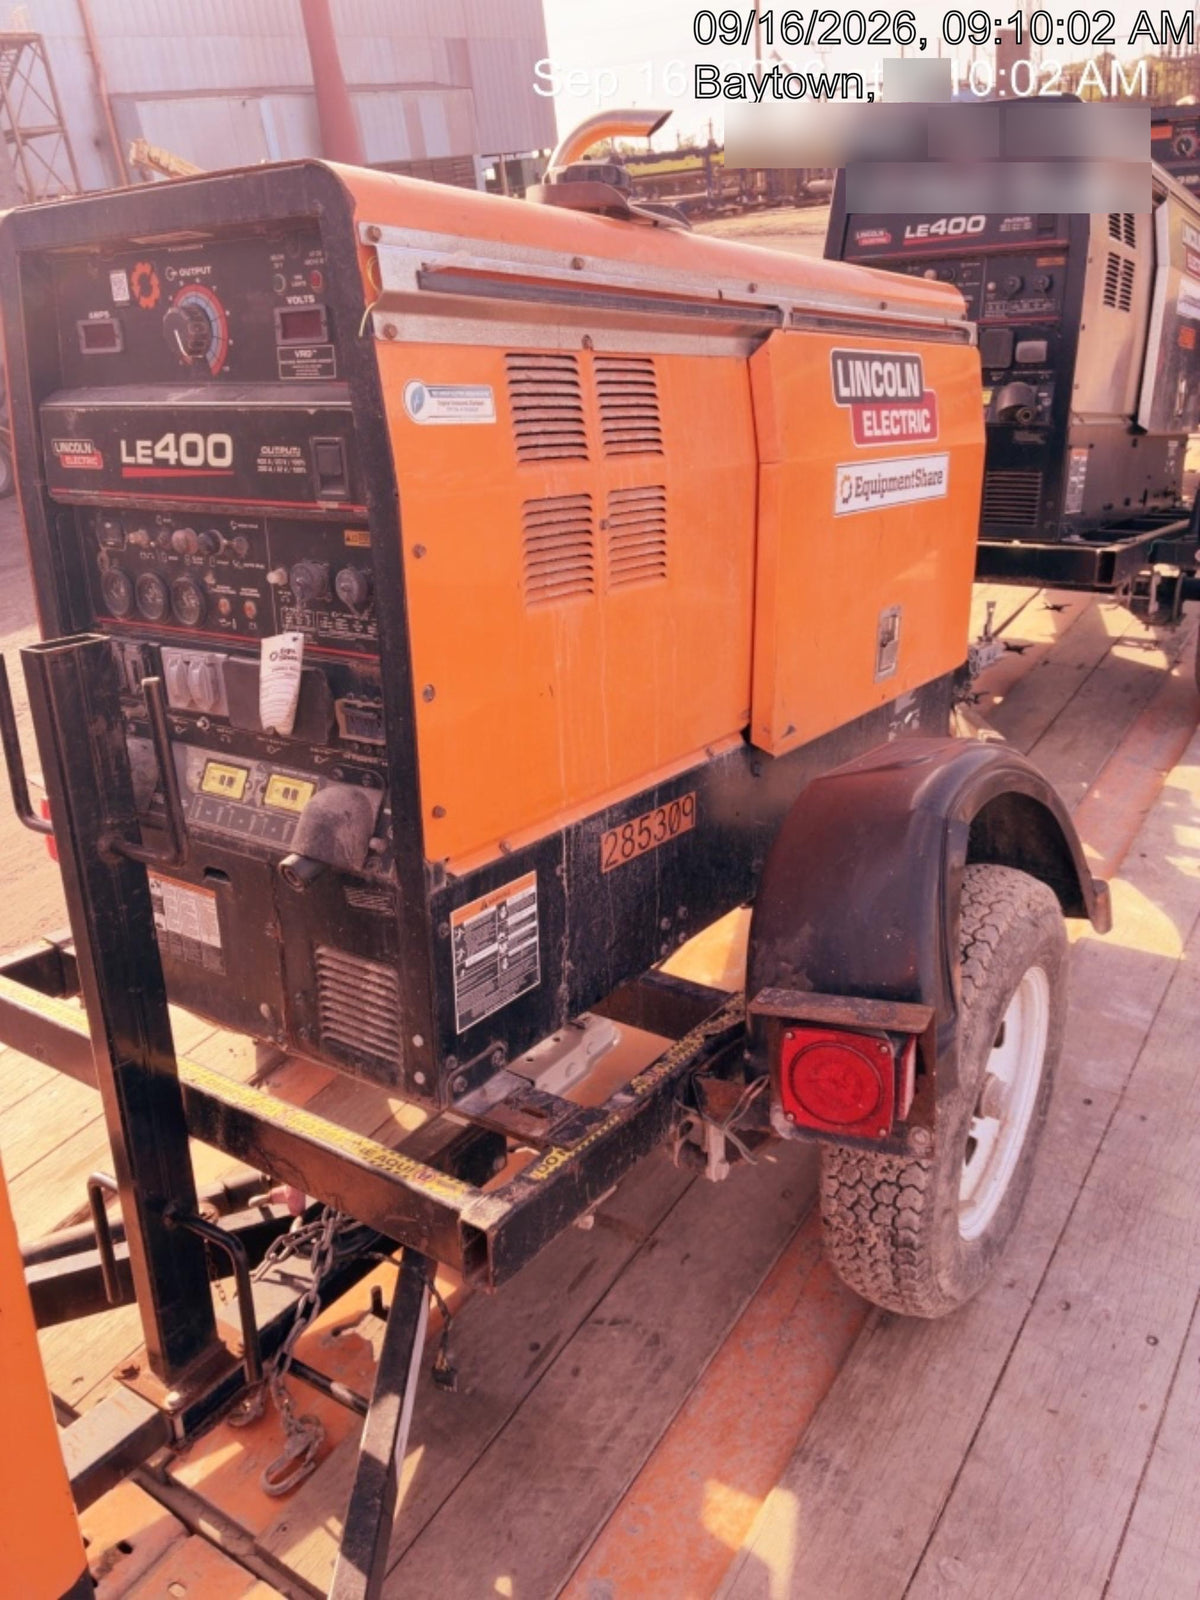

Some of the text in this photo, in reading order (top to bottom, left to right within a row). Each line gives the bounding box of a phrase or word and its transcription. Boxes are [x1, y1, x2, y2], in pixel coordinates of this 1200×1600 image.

[904, 214, 986, 239] LE400
[179, 266, 212, 276] OUTPUT
[286, 294, 316, 305] VOLTS
[837, 358, 921, 399] LINCOLN
[861, 408, 931, 438] ELECTRIC
[54, 441, 92, 454] LINCOLN
[120, 432, 235, 468] LE400
[854, 467, 944, 502] EquipmentShare
[604, 794, 695, 870] 285309
